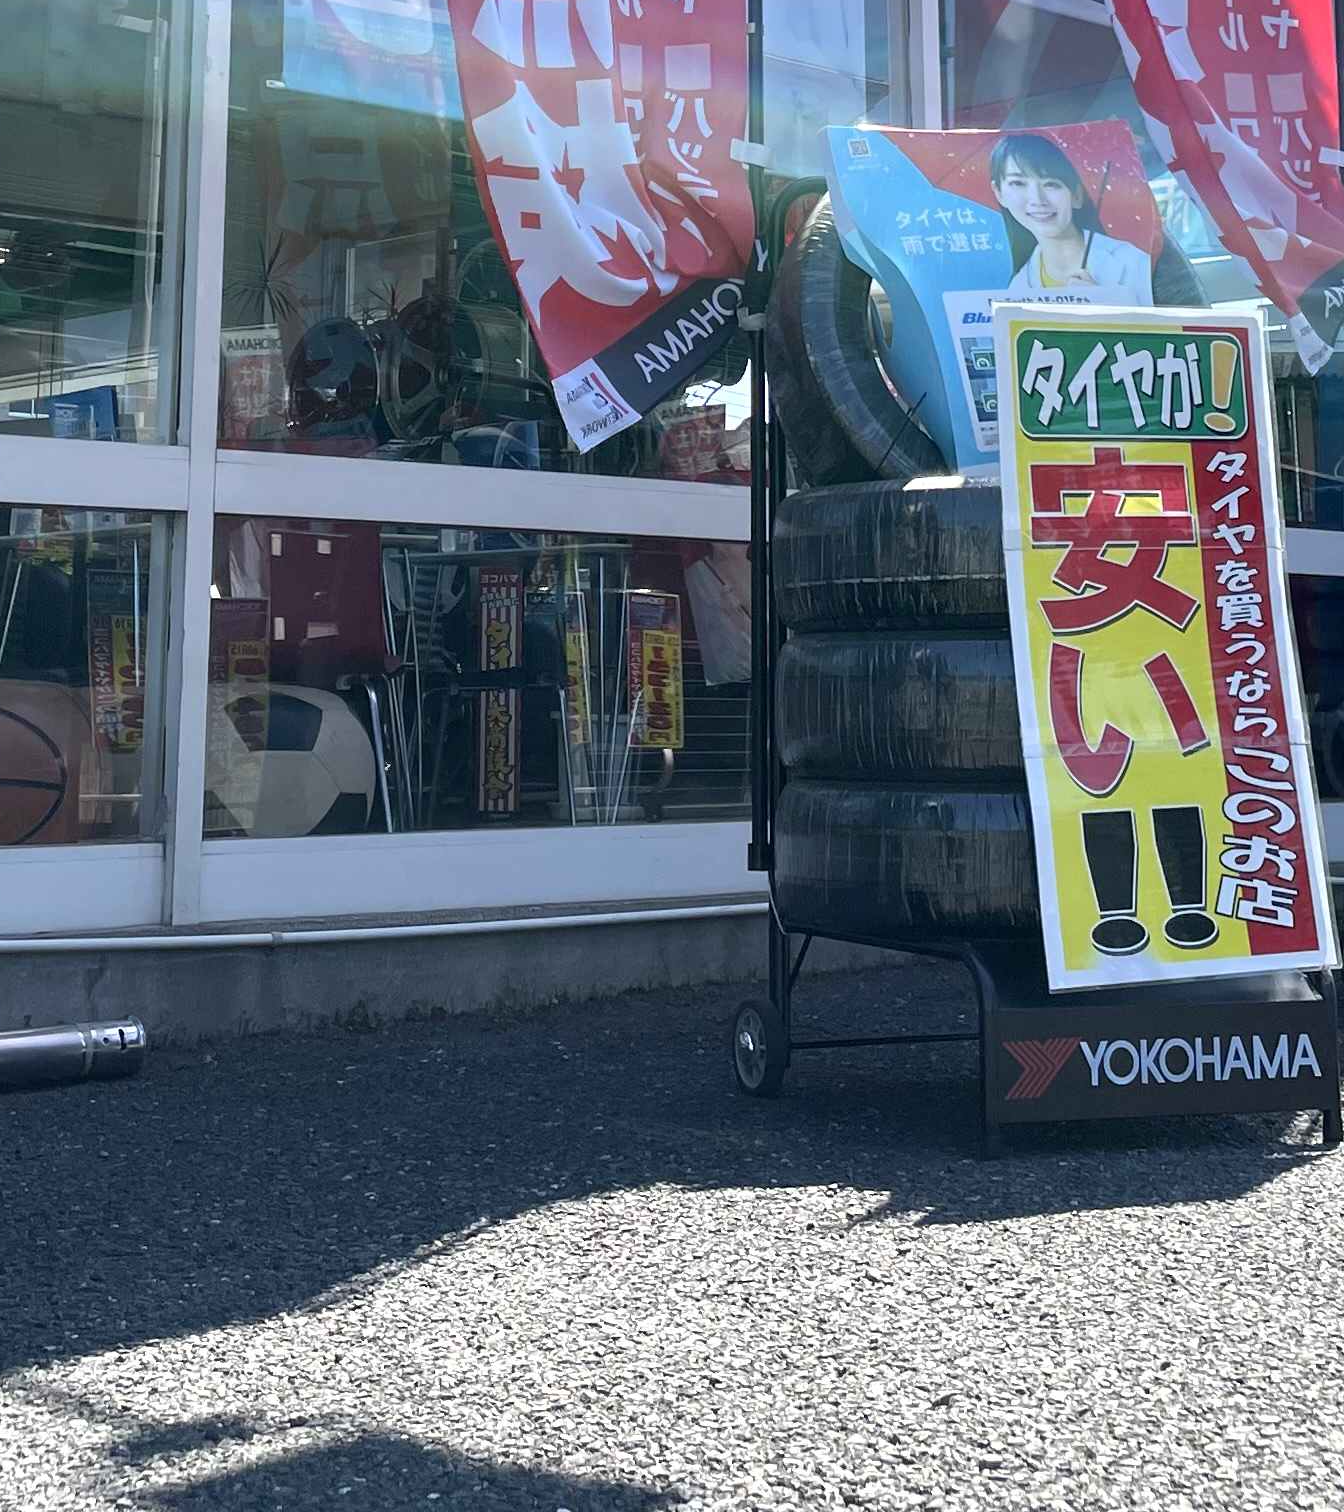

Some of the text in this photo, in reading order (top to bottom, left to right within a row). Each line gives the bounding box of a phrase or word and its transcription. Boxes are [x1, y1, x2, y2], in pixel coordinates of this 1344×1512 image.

[1022, 338, 1239, 434] タイヤが!
[1029, 445, 1219, 954] 安い!!
[1206, 449, 1300, 929] タイヤを買うならこのお店
[1079, 1033, 1323, 1087] YOKOHAMA
